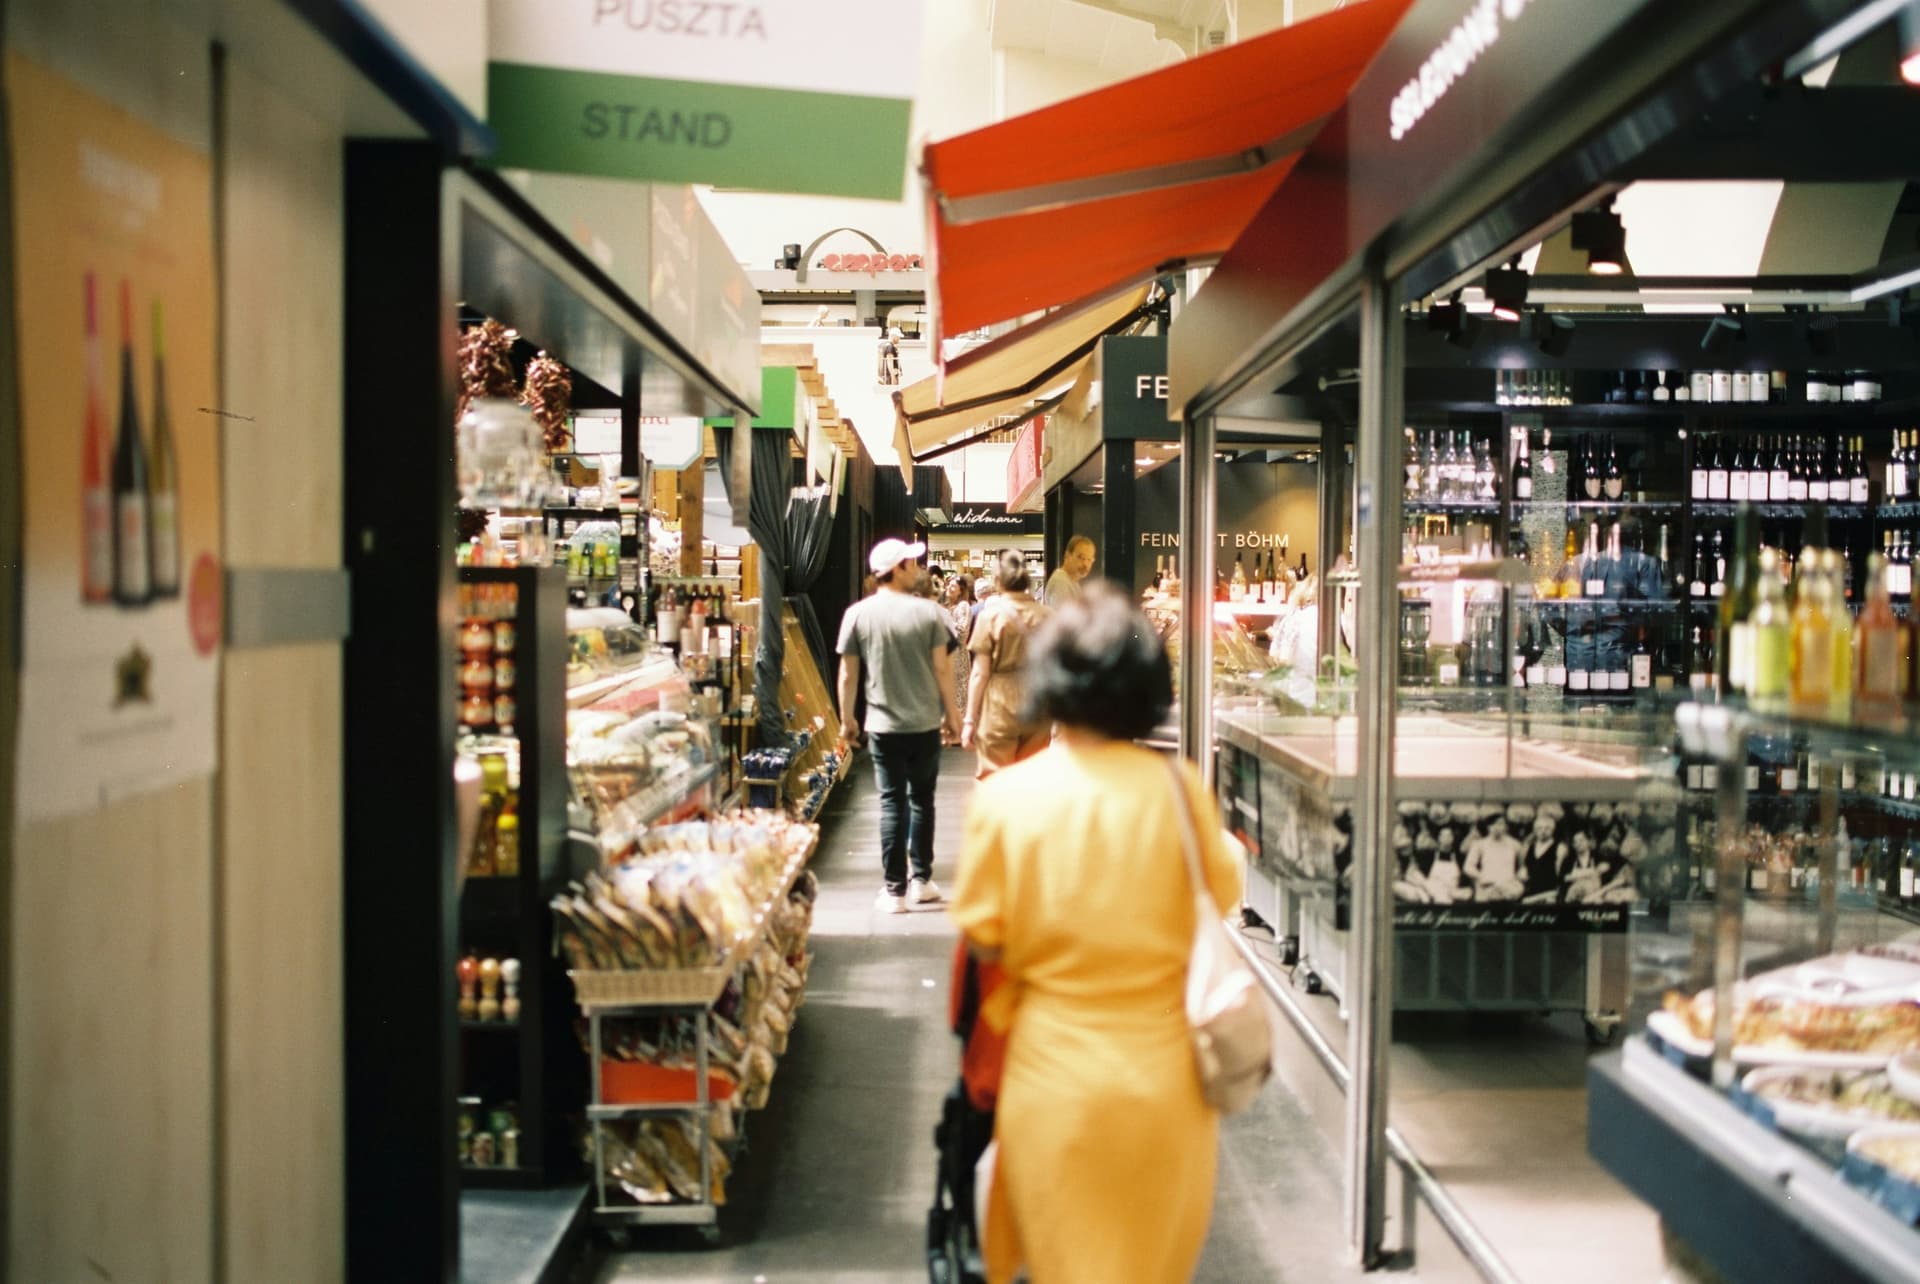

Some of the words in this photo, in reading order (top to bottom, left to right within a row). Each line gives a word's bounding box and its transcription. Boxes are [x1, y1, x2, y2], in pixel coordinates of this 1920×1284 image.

[592, 0, 767, 39] PUSZTA
[583, 101, 733, 148] STAND
[1136, 376, 1168, 399] FE
[953, 508, 1023, 524] Widmann
[1141, 533, 1228, 547] FEINT
[1235, 531, 1289, 548] BÖHM
